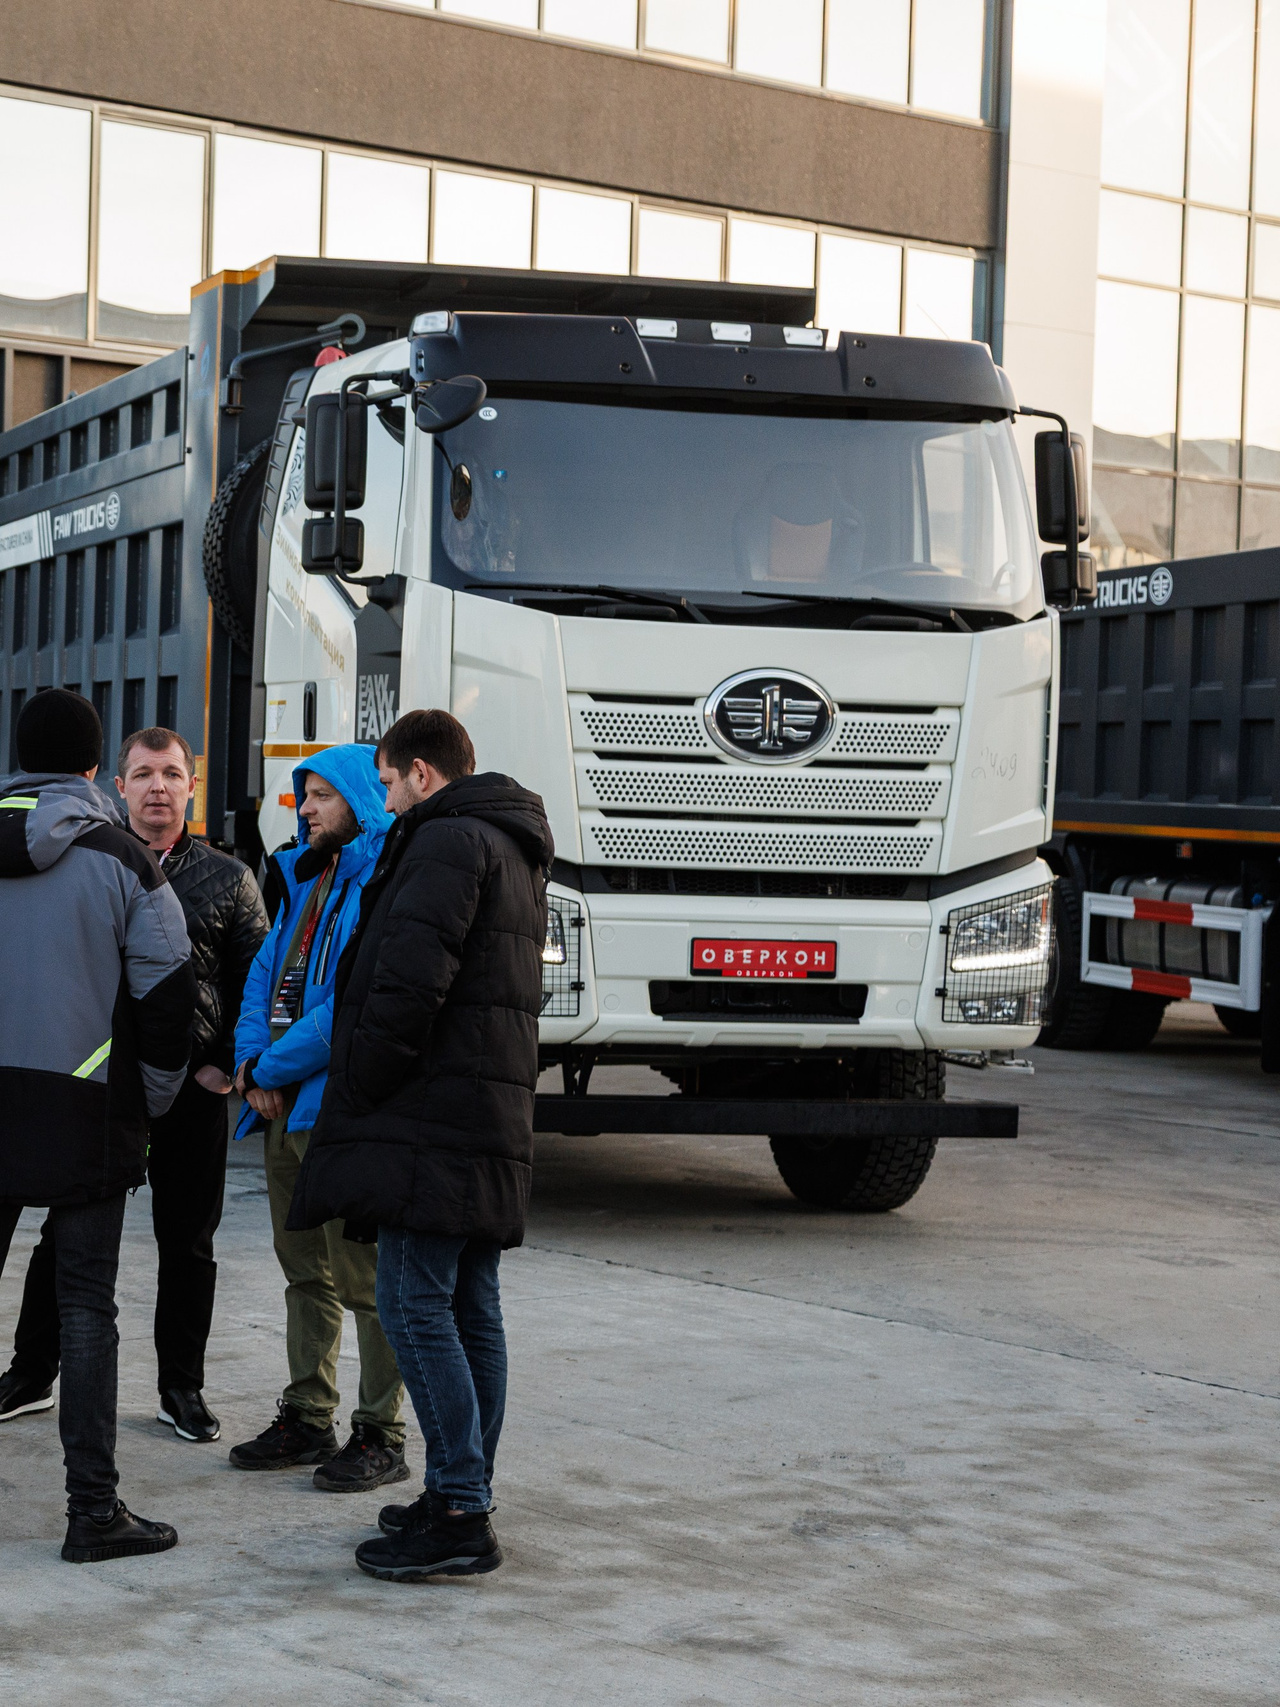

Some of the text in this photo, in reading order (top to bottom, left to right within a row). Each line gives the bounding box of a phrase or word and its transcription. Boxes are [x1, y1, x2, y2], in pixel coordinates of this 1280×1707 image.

[72, 501, 106, 536] TRUCKS
[701, 948, 826, 966] ОВЕРКОН
[736, 969, 794, 978] ОВЕРКОН
